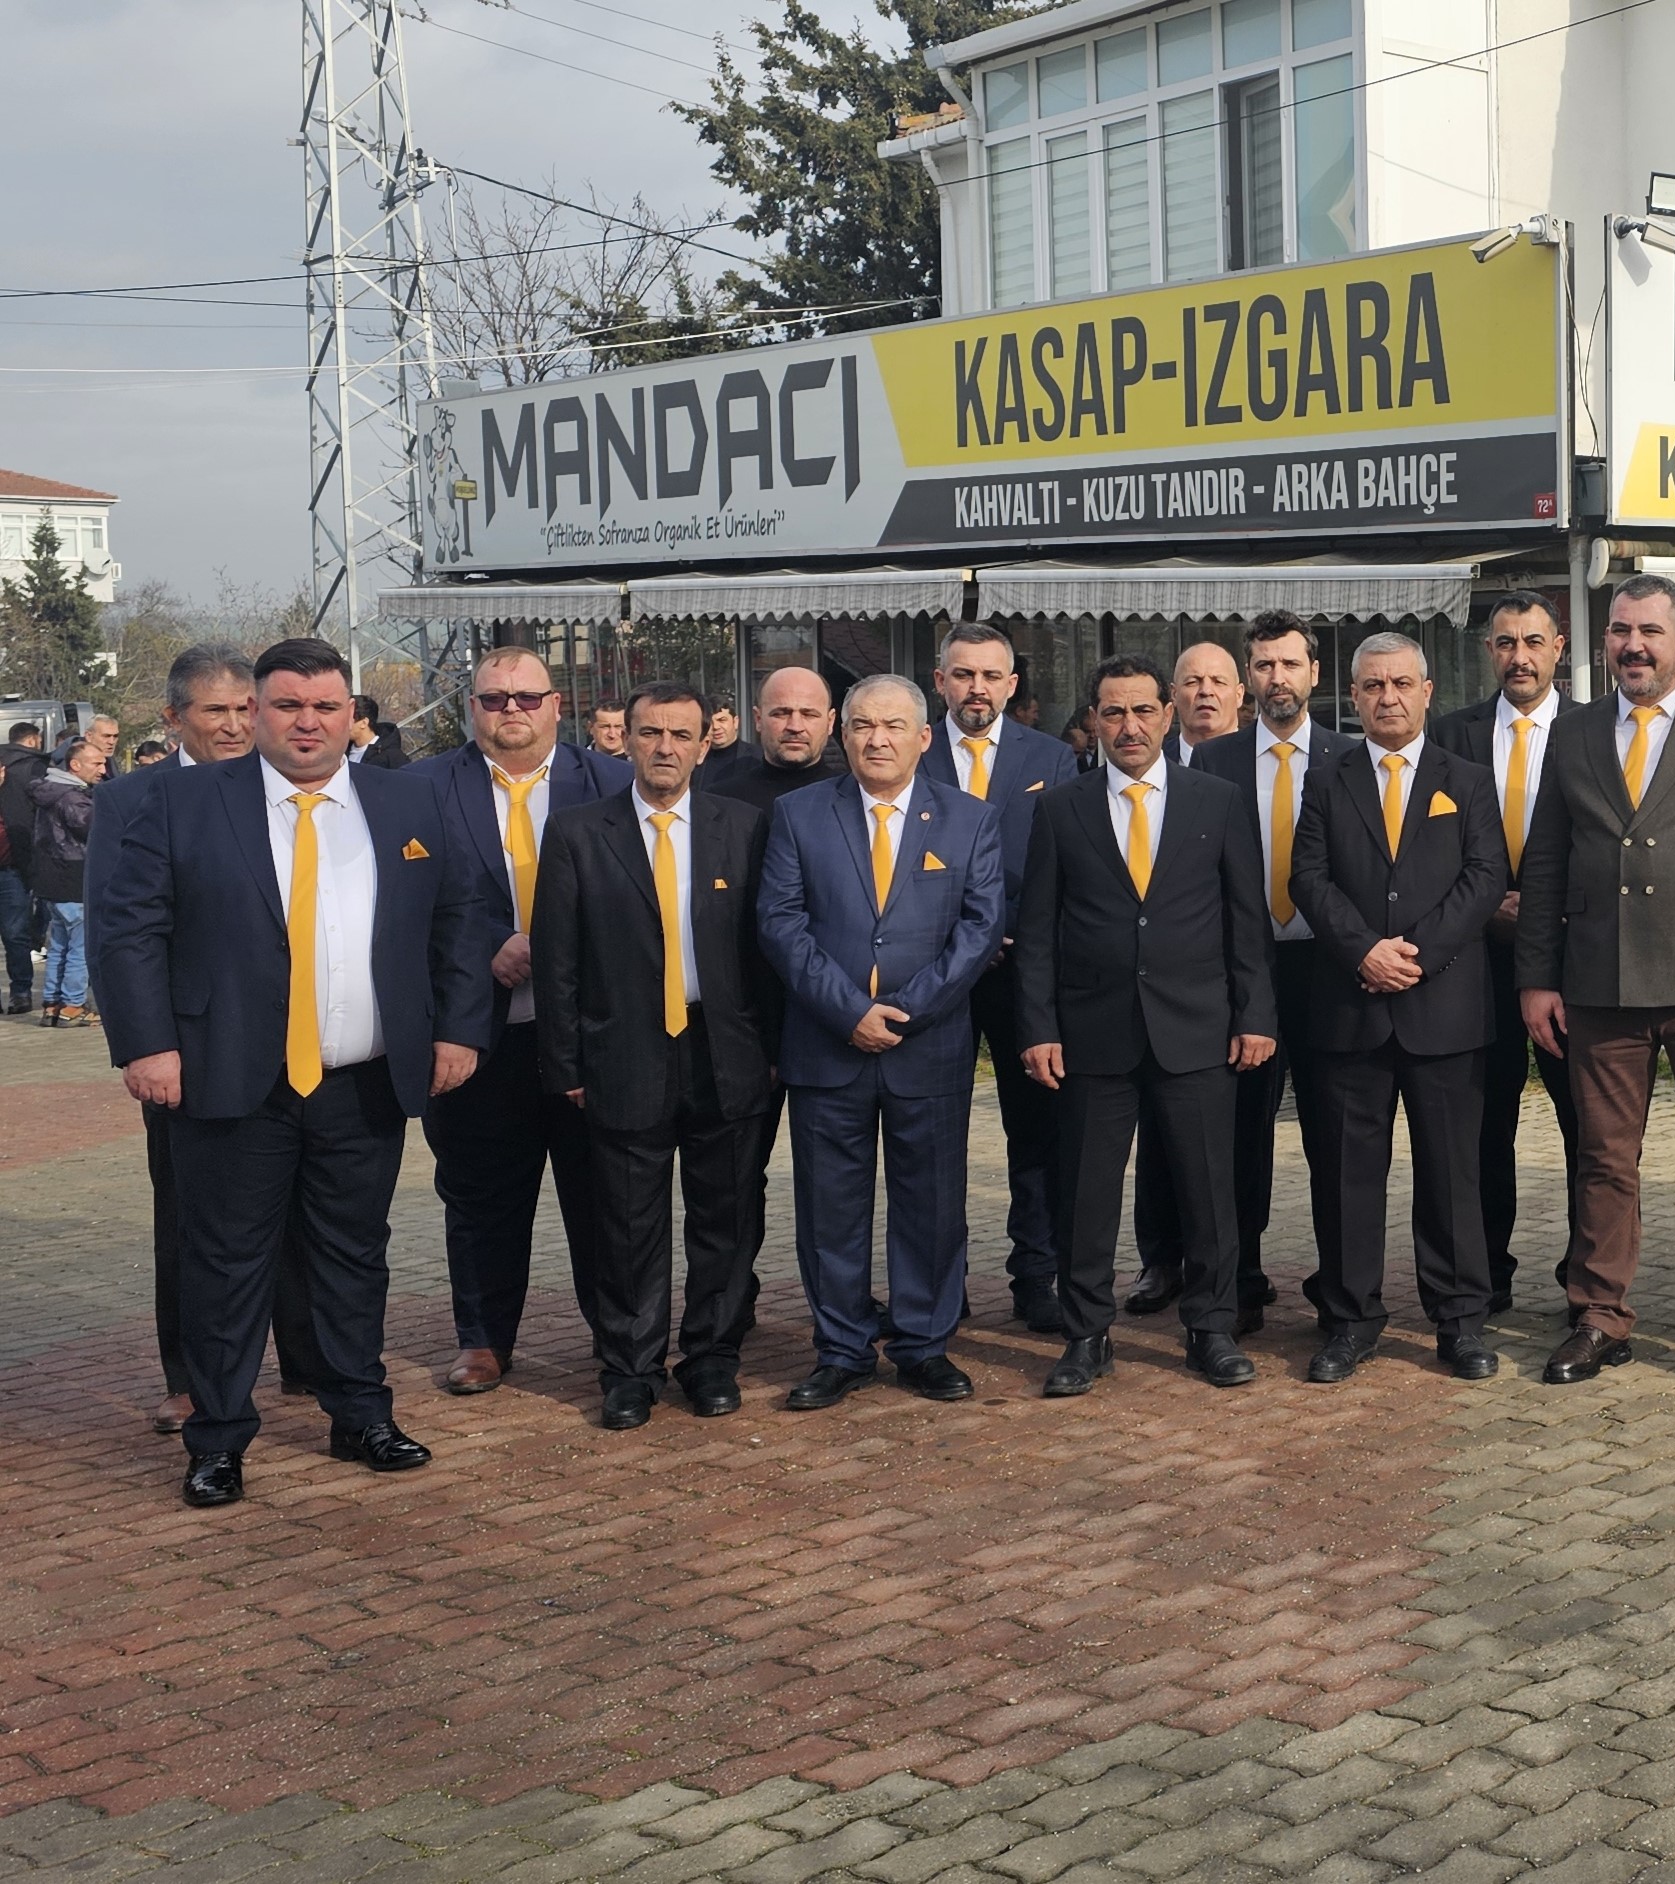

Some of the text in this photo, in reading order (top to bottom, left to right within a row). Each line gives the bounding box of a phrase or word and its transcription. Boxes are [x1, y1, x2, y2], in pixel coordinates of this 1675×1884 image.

[954, 271, 1450, 448] KASAP-IZGARA
[481, 355, 860, 527] MANDACI
[955, 483, 1061, 528] KAHVALTI
[1083, 475, 1144, 523] KUZU
[1151, 468, 1245, 518] TANDIR
[1273, 461, 1348, 513] ARKA
[1356, 452, 1458, 515] BAHÇE
[598, 519, 650, 547] Sofranıza
[654, 514, 702, 550] Organik
[706, 516, 720, 539] Et
